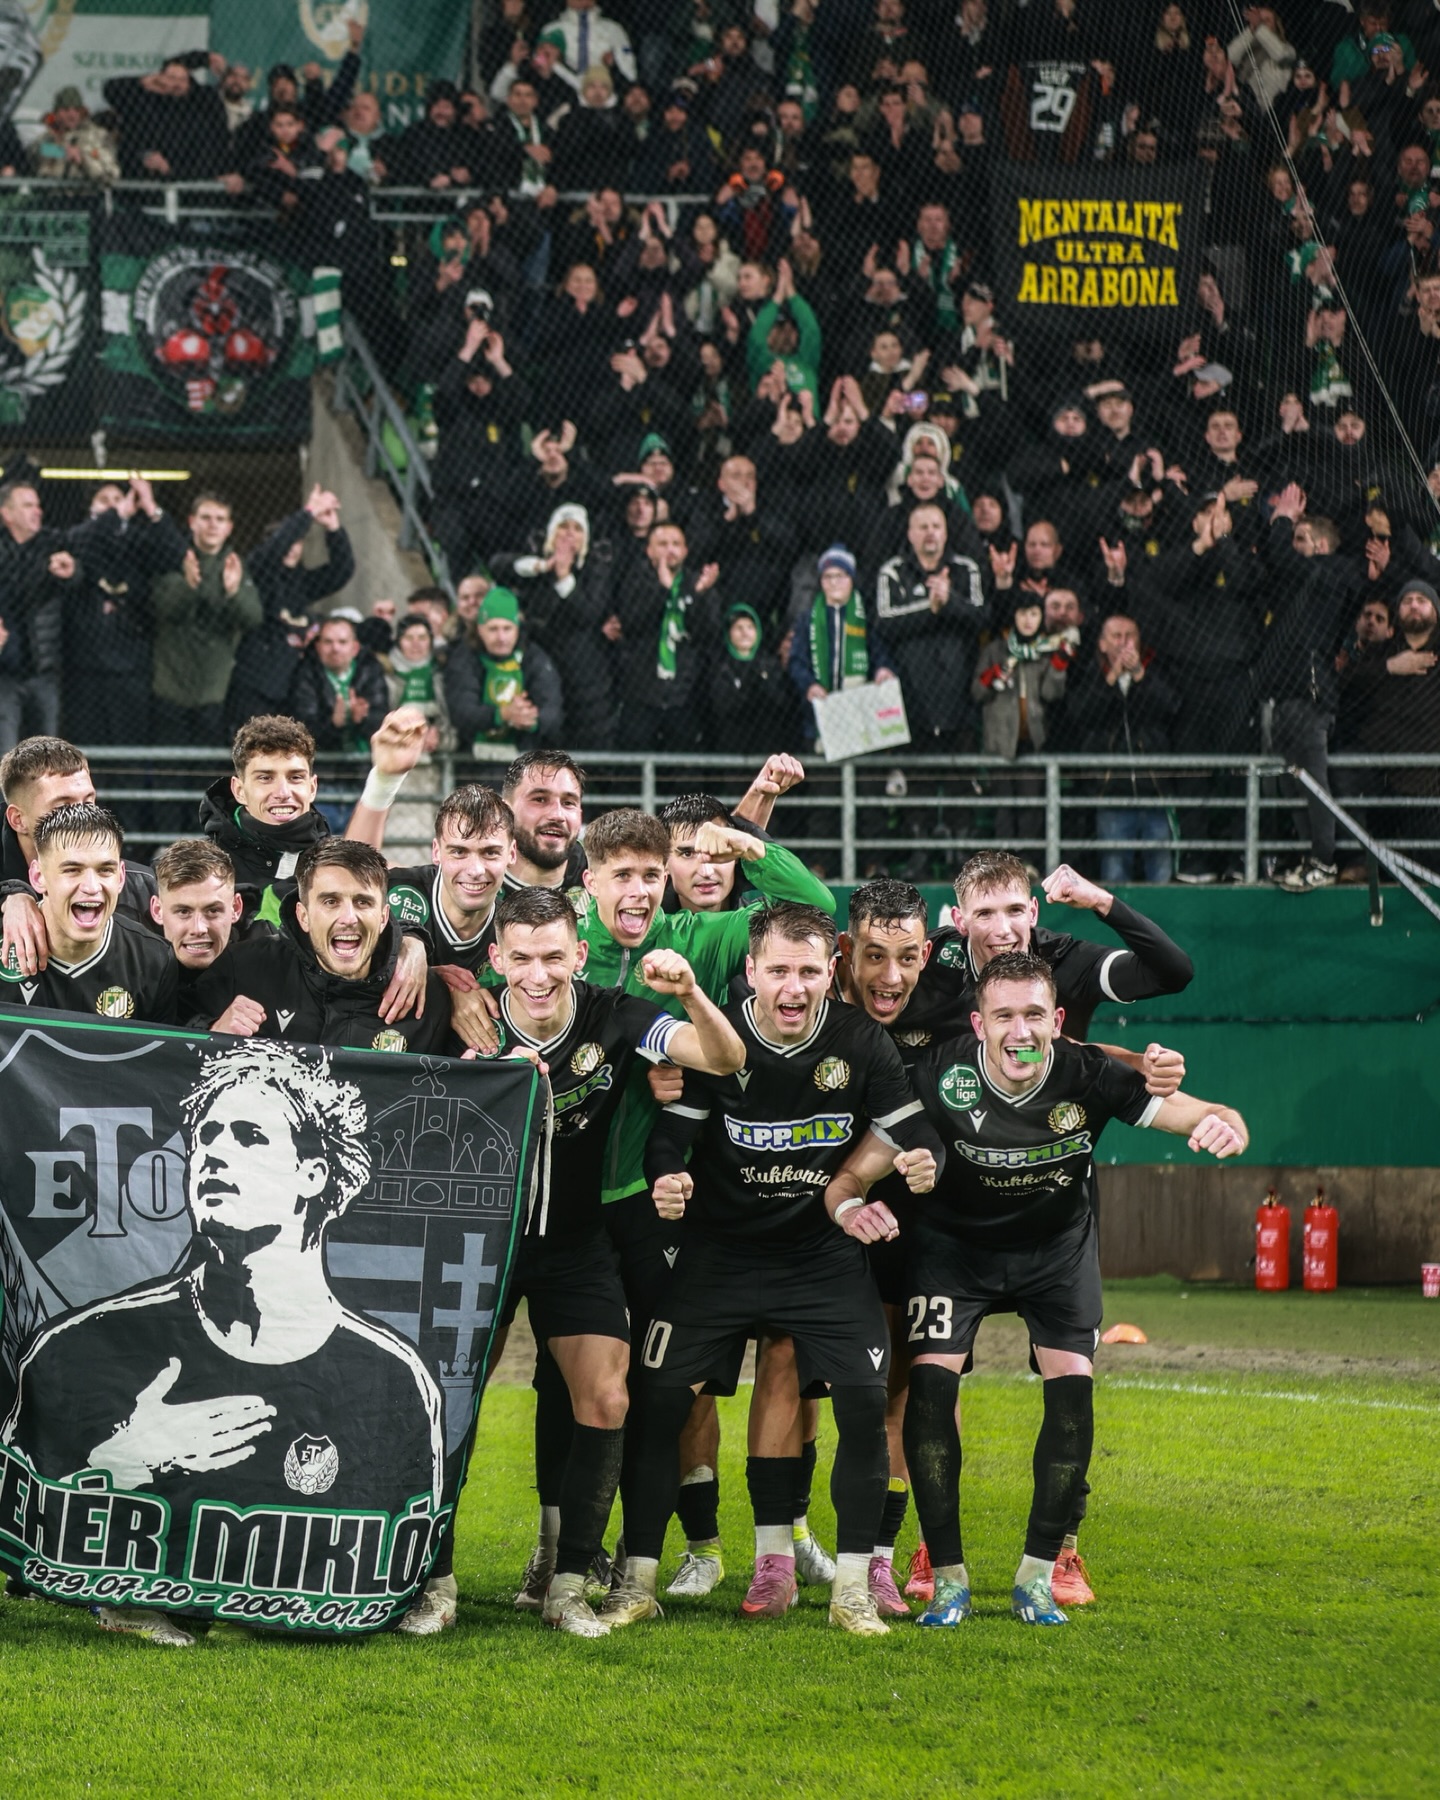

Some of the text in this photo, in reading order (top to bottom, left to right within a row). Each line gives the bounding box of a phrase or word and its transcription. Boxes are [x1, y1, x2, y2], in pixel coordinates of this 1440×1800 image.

[1030, 82, 1077, 133] 29
[1056, 240, 1145, 264] ULTRA
[1017, 262, 1179, 307] ARRABONA
[403, 898, 423, 914] fizz
[956, 1077, 976, 1088] fizz
[956, 1089, 977, 1102] liga
[740, 1165, 831, 1187] Kukkonia
[980, 1168, 1073, 1187] Kukkonia
[907, 1296, 953, 1342] 23
[0, 1450, 163, 1574] EHÉR
[24, 1557, 193, 1605] 1979.07.20
[217, 1592, 396, 1630] 2004.01.25
